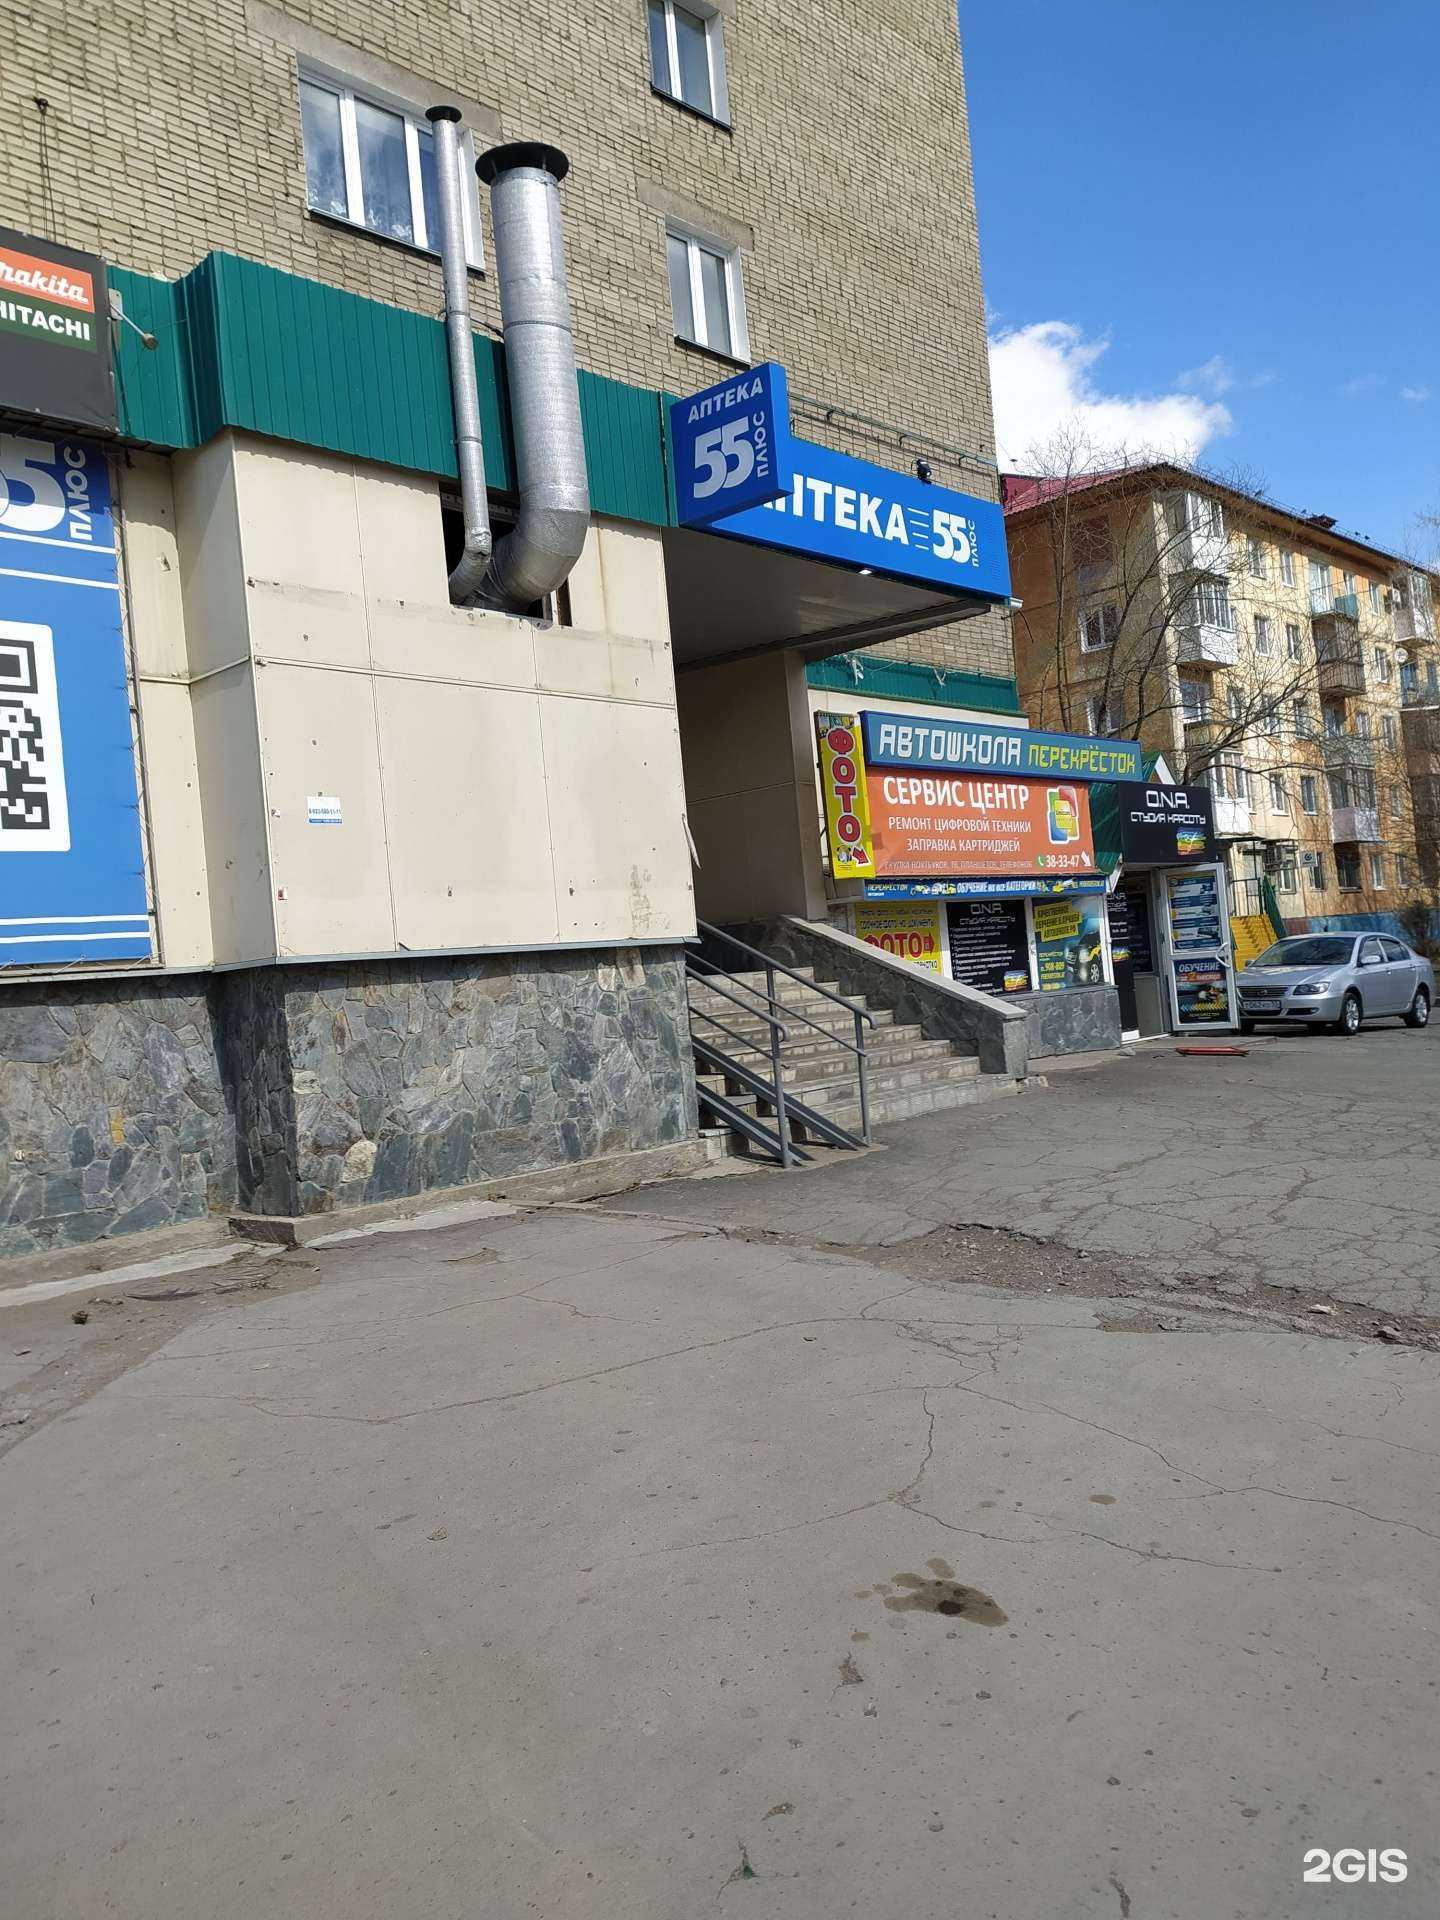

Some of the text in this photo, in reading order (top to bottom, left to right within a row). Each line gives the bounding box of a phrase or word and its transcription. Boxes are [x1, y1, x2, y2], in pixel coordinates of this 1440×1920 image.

[687, 377, 764, 425] АПТЕКА
[693, 416, 755, 499] 55
[753, 411, 769, 478] ПЛЮС
[0, 433, 66, 532] 5
[63, 446, 93, 541] ПЛЮС
[763, 473, 909, 545] ПТЕКА
[932, 508, 971, 564] 55
[970, 519, 979, 567] ПЛЮС
[879, 724, 1136, 775] АВТОШКОЛА ПЕРЕКРЁСТОК
[827, 728, 861, 843] ФОТО
[883, 776, 1030, 815] СЕРВИС ЦЕНТР
[888, 815, 1032, 833] РЕМОНТ ЦИФРОВОЙ ТЕХНИКИ
[1130, 811, 1206, 824] СТУДИЯ КРАСОТЫ
[906, 838, 1020, 854] ЗАПРАВКА КАРТРИДЖЕЙ
[1045, 855, 1079, 868] 38-33-47
[1178, 962, 1220, 973] ОБУЧЕНИЕ
